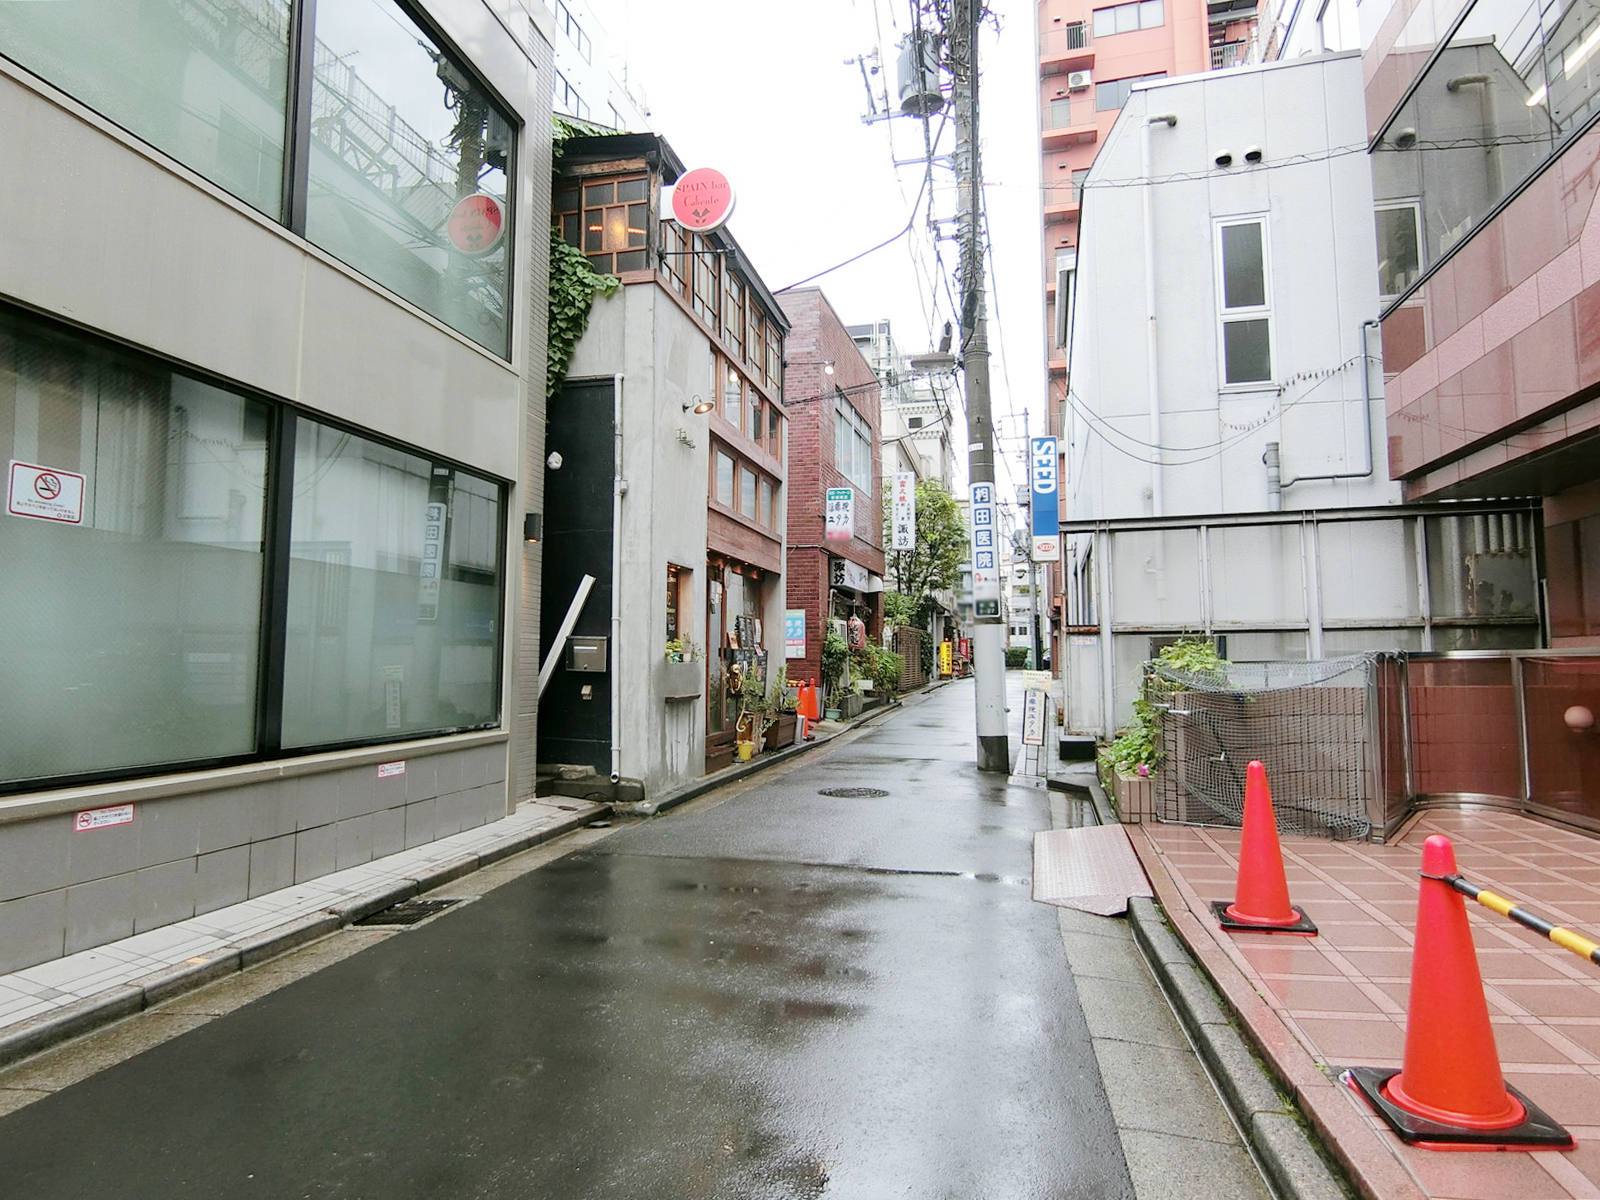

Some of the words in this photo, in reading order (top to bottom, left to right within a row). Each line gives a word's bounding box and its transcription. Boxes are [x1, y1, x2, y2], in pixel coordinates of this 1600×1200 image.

[676, 182, 708, 193] SPAIN
[711, 181, 728, 190] bar
[1032, 440, 1057, 495] SEED
[897, 524, 909, 547] 諏訪
[975, 488, 992, 568] 相田医院
